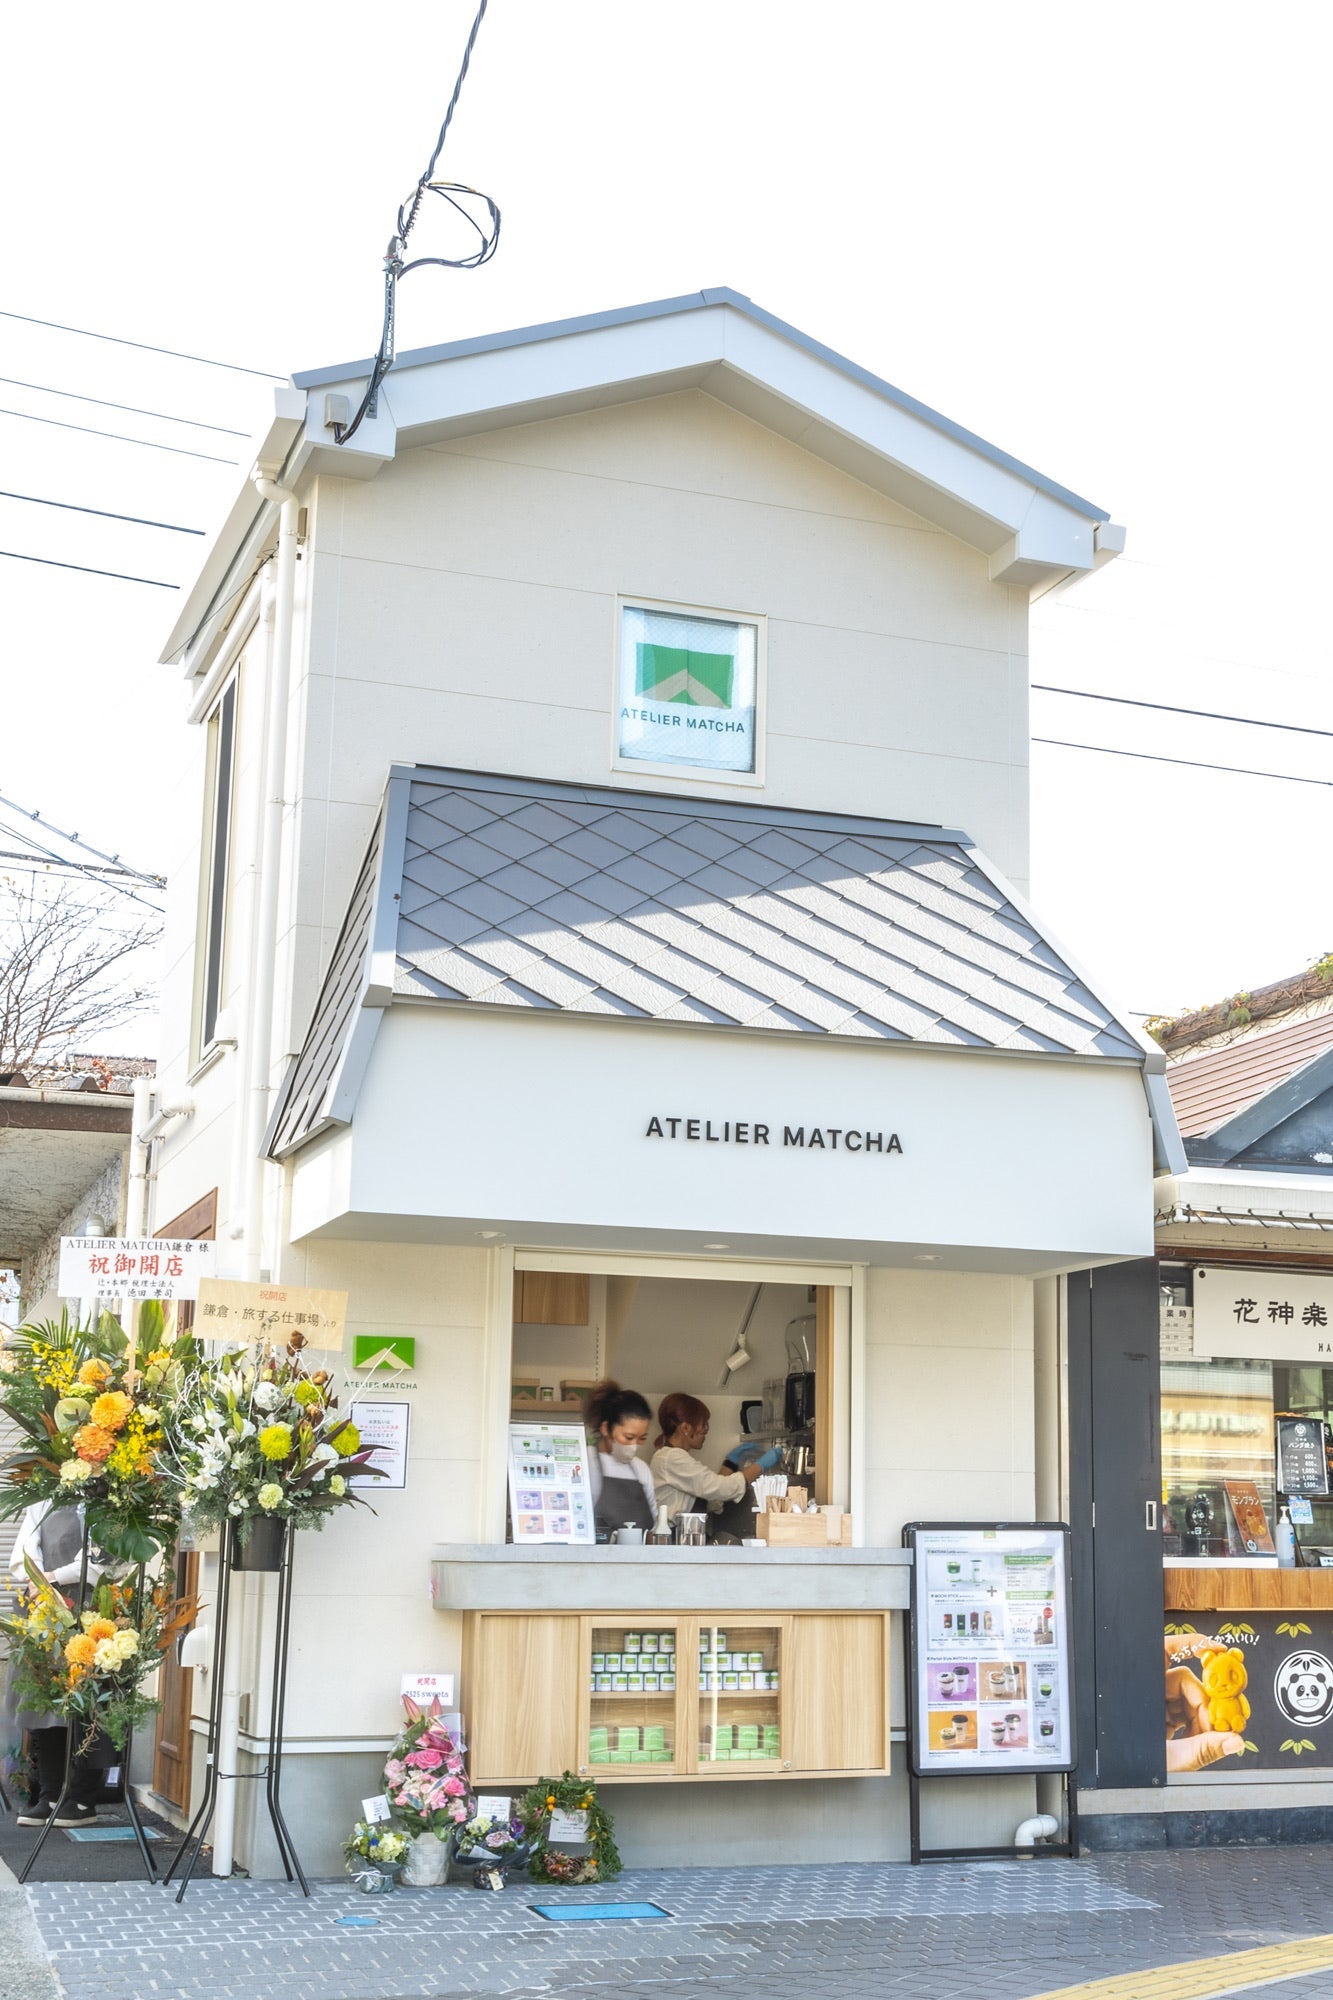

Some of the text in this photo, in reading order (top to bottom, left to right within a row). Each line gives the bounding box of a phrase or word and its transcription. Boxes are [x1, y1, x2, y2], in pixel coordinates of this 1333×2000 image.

[621, 707, 745, 733] ATELIER MATCHA
[645, 1116, 904, 1154] ATELIER MATCHA
[67, 1239, 116, 1250] ATELIER
[199, 1242, 209, 1253] 様
[88, 1253, 184, 1277] 祝御開店
[259, 1289, 288, 1302] 祝開店
[1233, 1298, 1328, 1328] 花神楽
[382, 1381, 418, 1390] MATCHA
[1231, 1495, 1260, 1506] モンブラン
